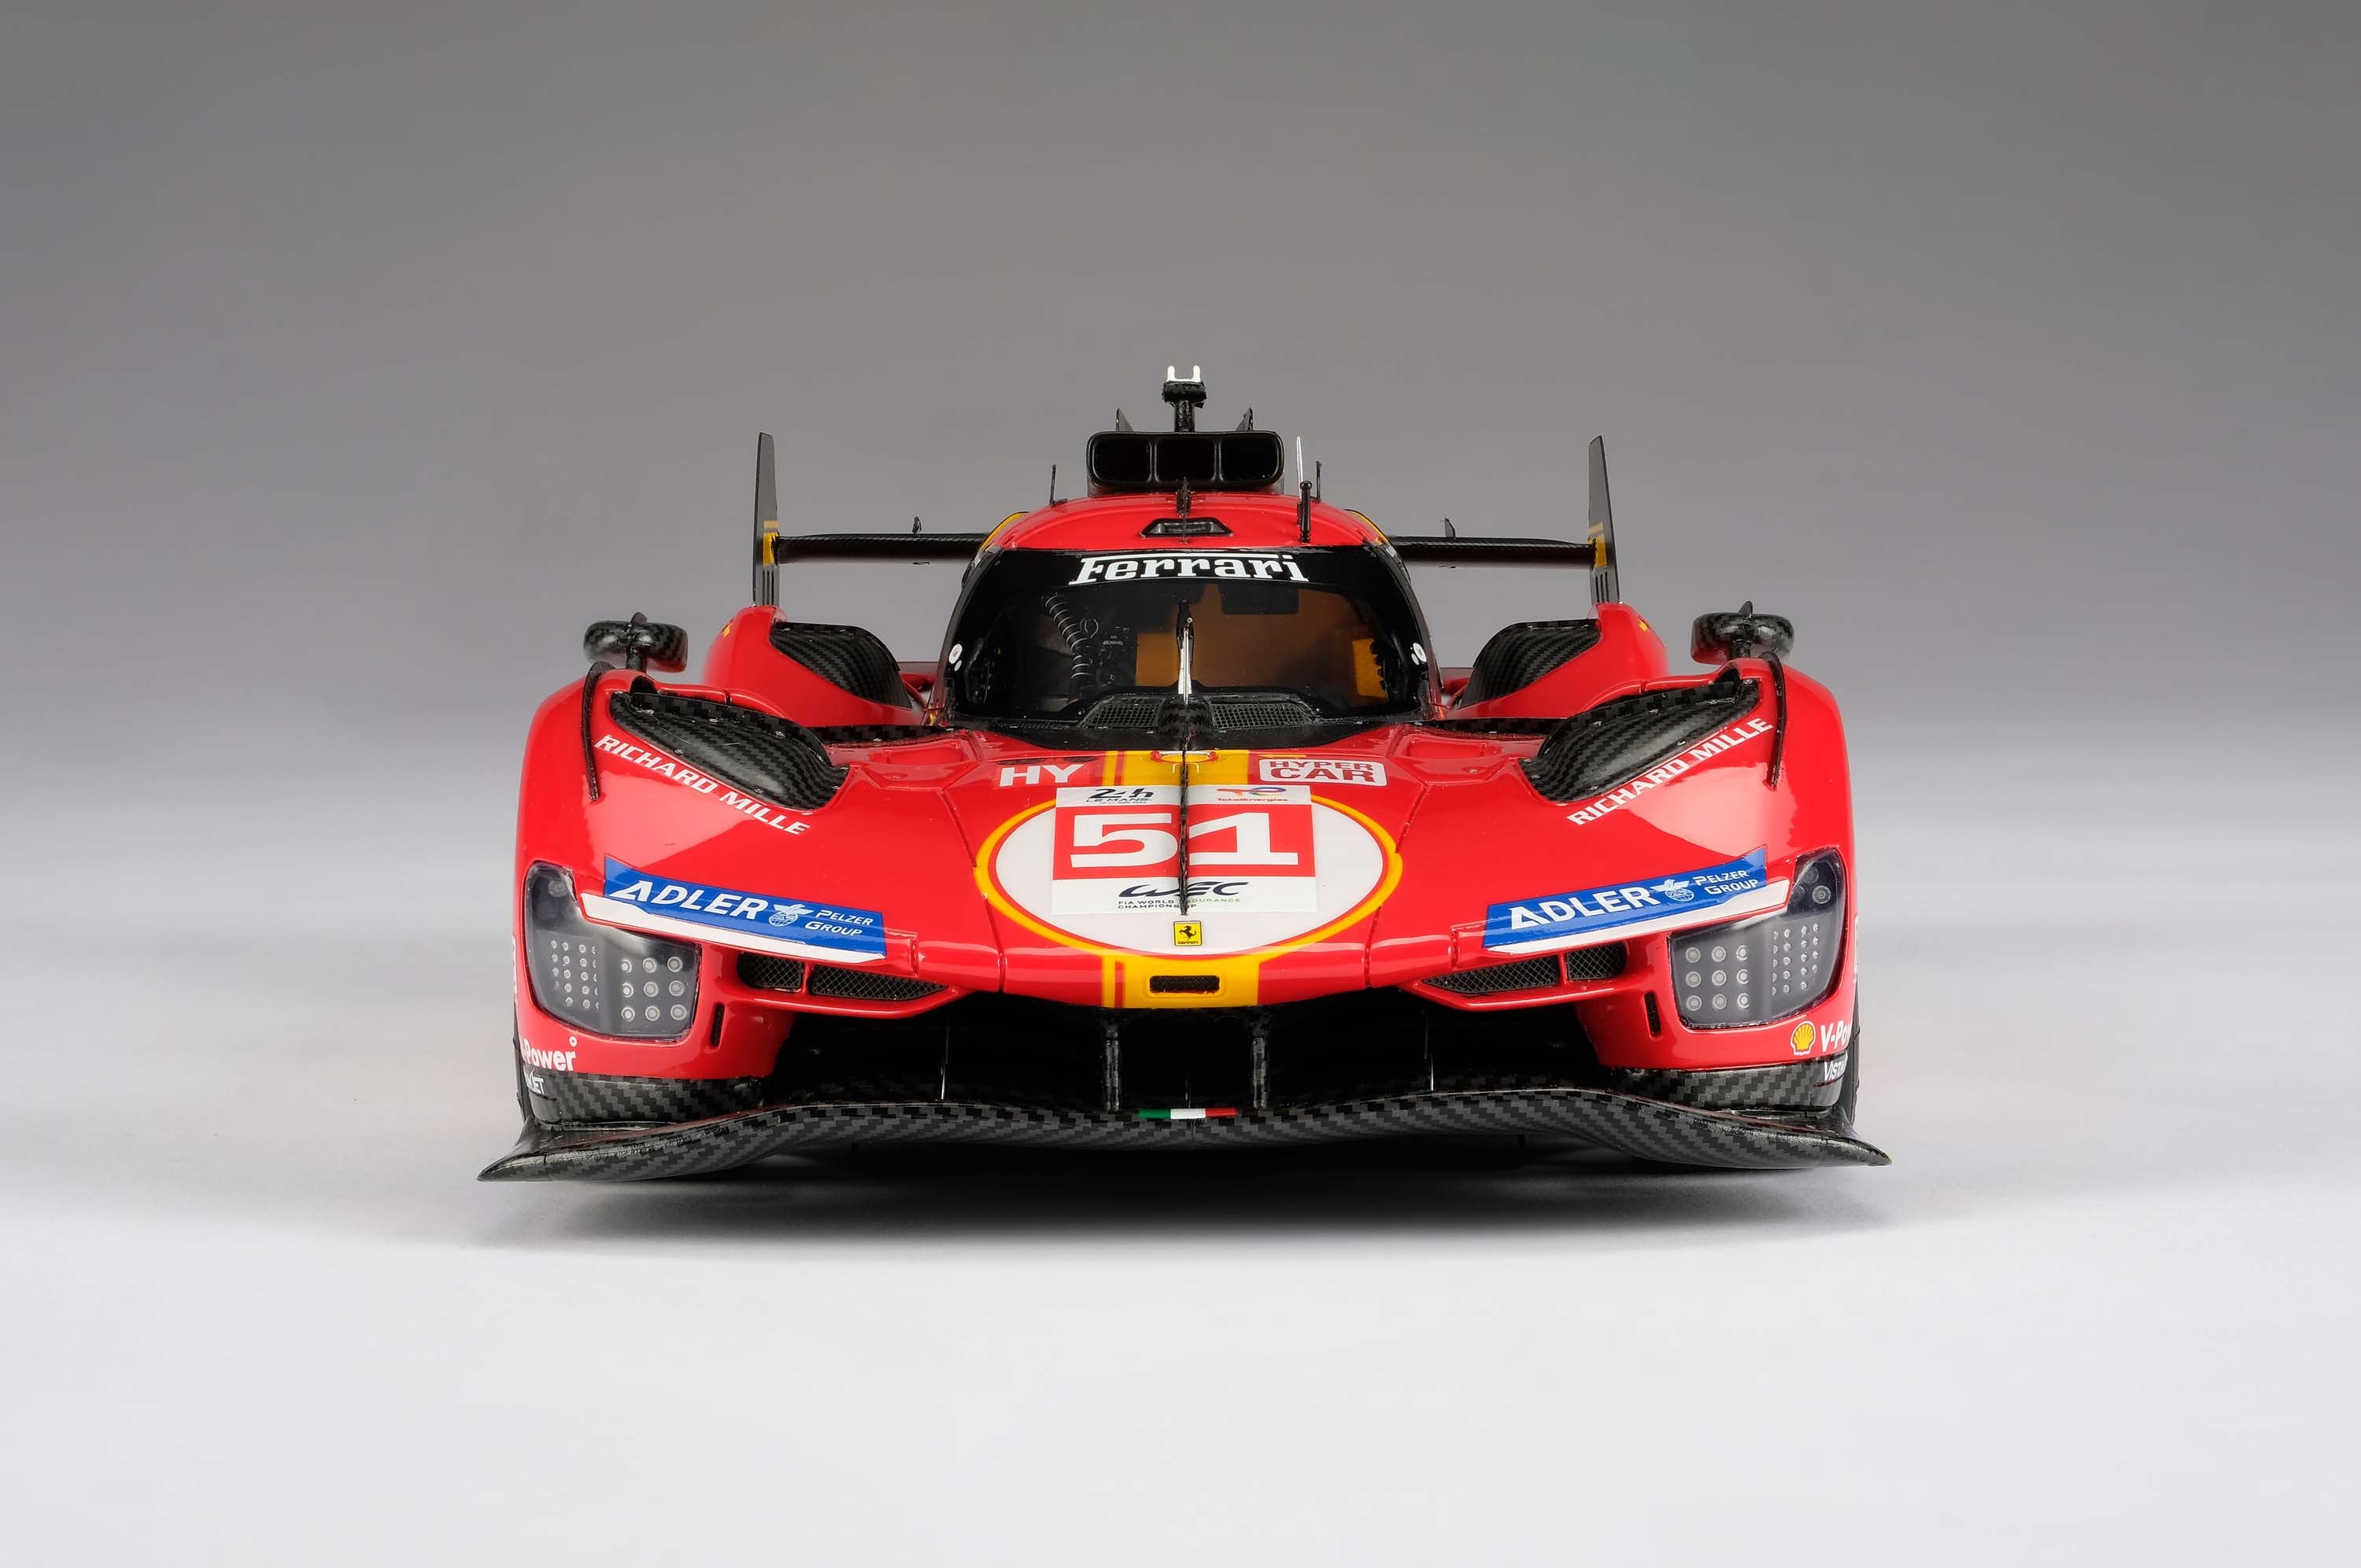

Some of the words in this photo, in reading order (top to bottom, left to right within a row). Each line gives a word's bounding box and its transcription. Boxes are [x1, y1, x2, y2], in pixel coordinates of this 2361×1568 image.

[1068, 552, 1310, 585] Ferrari
[999, 763, 1084, 787] HY
[1269, 761, 1373, 770] HYPER
[1270, 767, 1375, 782] CAR
[1567, 758, 1693, 825] RICHARD
[1691, 718, 1775, 762] MILLE
[594, 734, 719, 794] RICHARD
[719, 791, 811, 835] MILLE
[1070, 812, 1299, 868] 51
[1692, 869, 1750, 887] PELZER
[1704, 878, 1759, 896] GROUP
[1118, 881, 1249, 898] WEC
[609, 880, 769, 921] ADLER
[1508, 887, 1661, 930] ADLER
[815, 909, 874, 927] PELZER
[804, 921, 863, 937] GROUP
